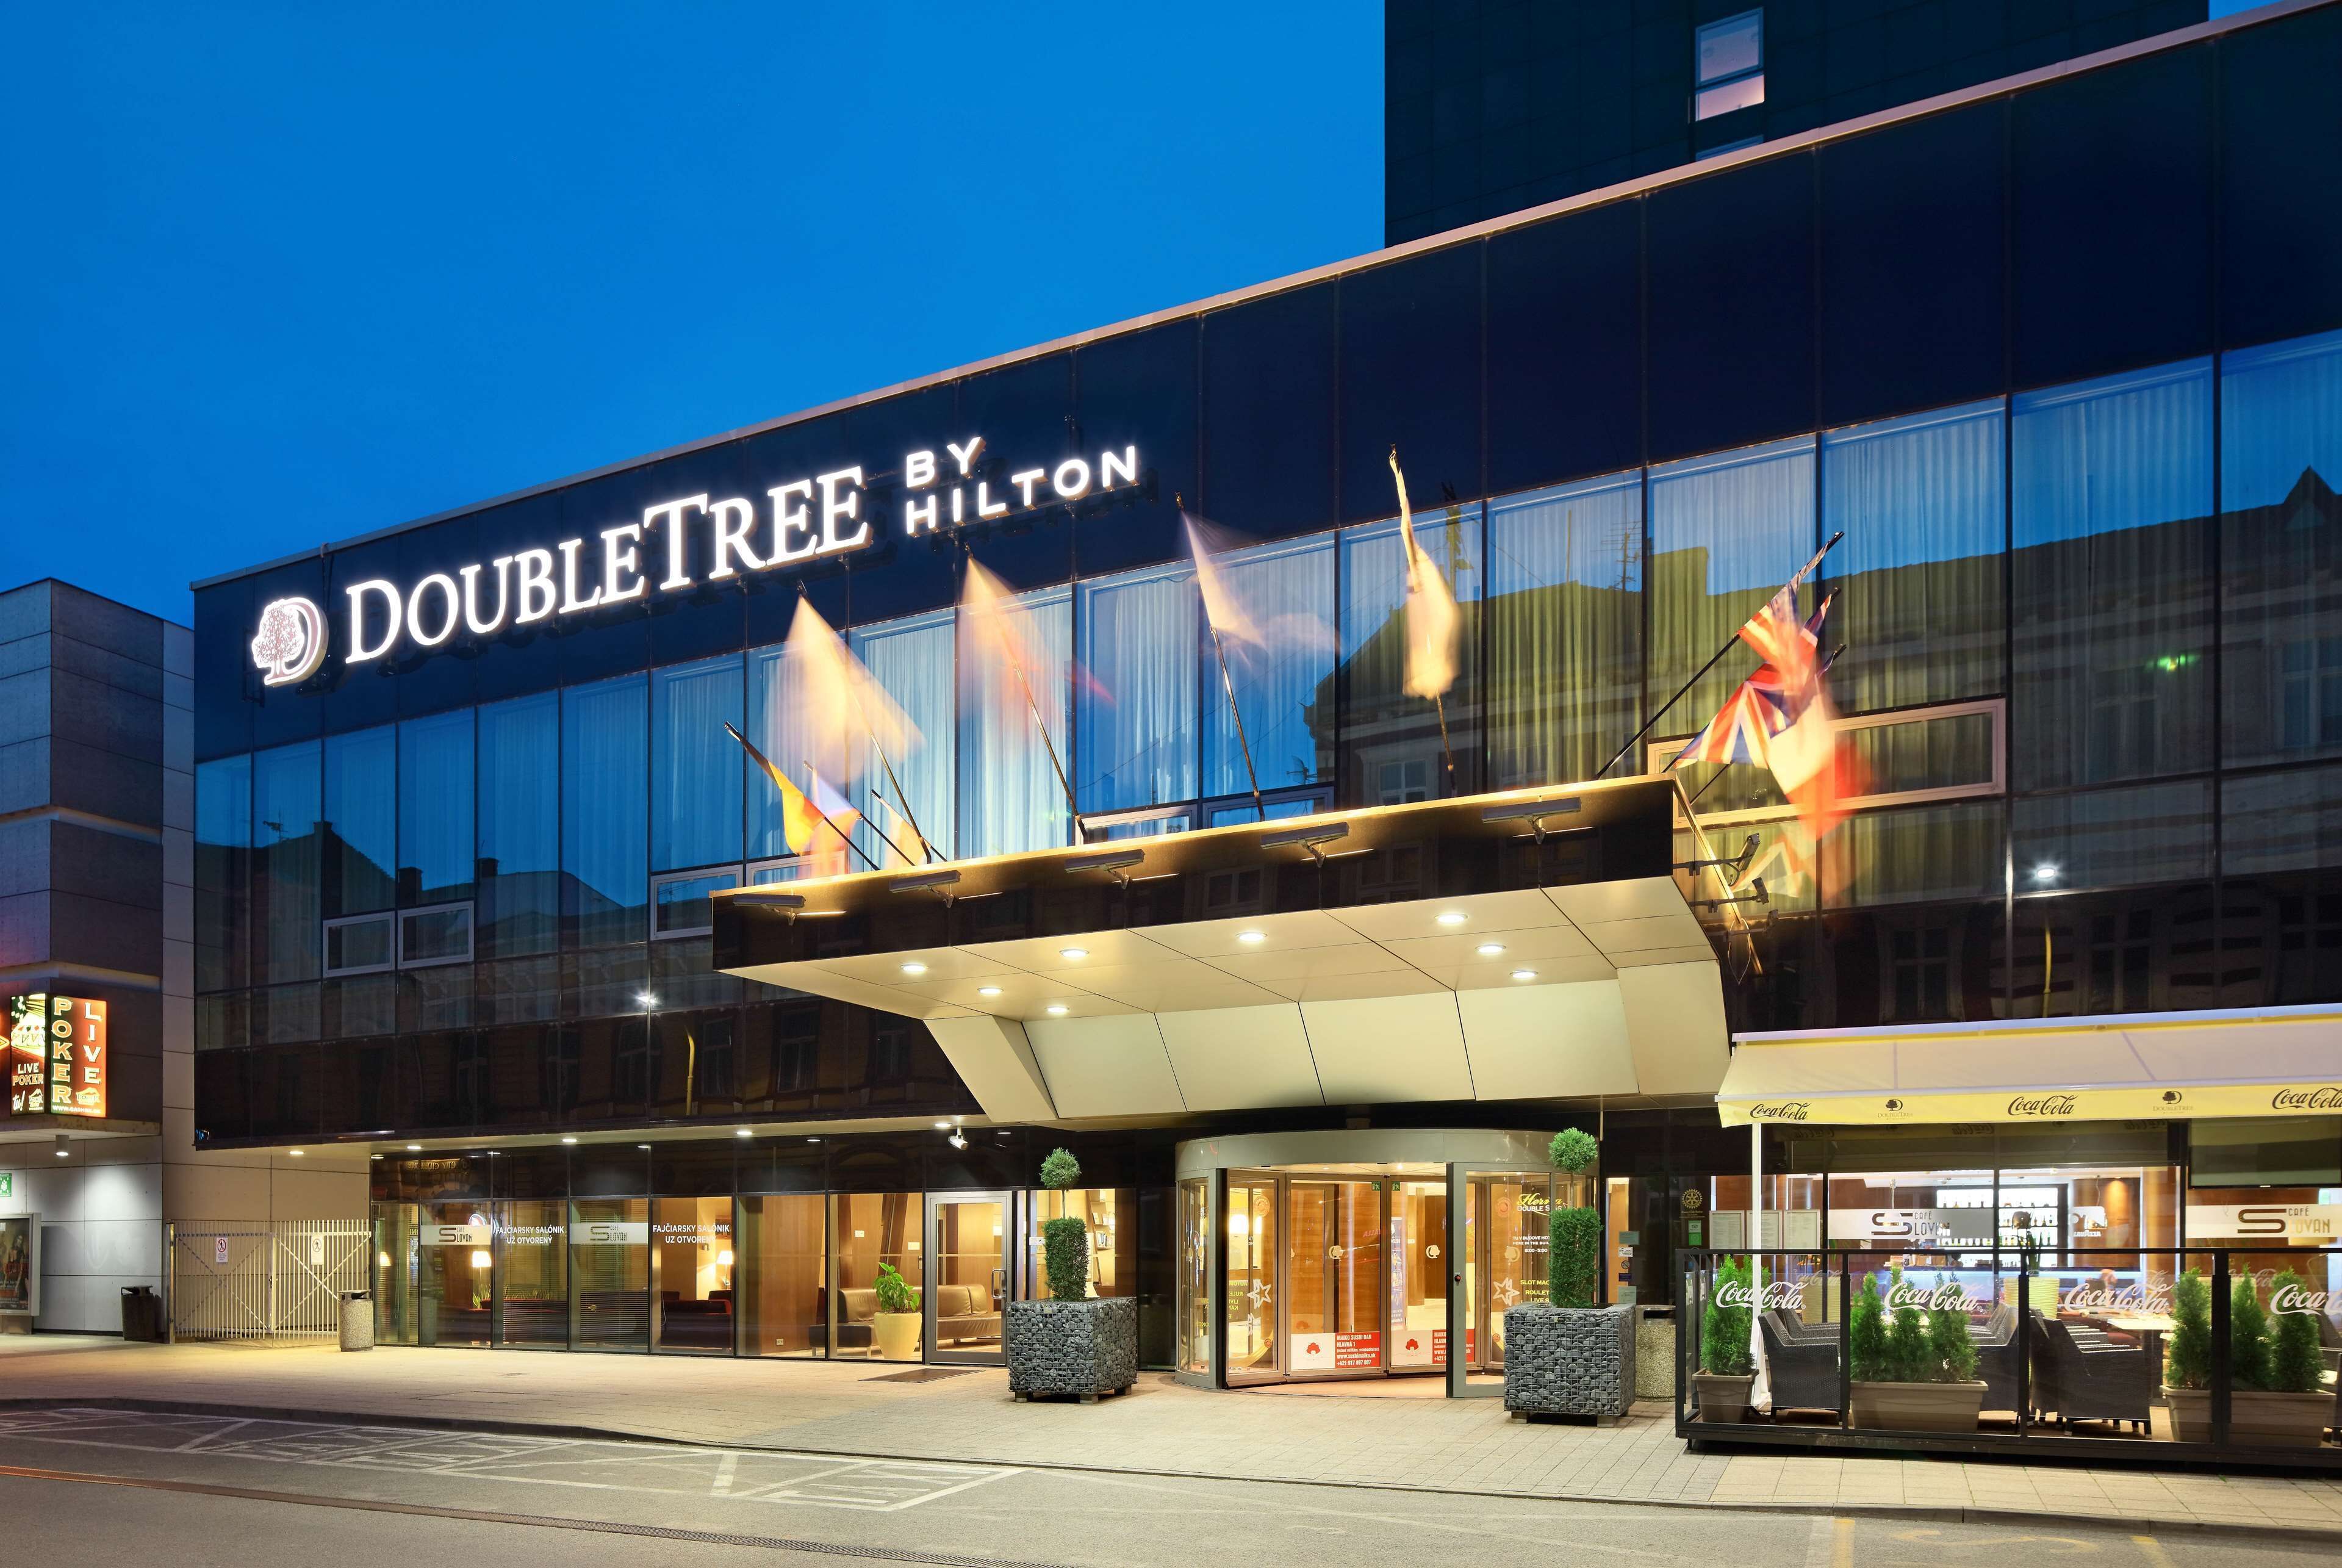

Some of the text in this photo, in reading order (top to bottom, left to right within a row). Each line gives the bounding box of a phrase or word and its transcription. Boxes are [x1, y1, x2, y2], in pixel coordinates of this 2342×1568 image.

[907, 436, 982, 487] BY
[907, 445, 1137, 535] HILTON
[51, 998, 72, 1103] POKER
[83, 1002, 102, 1085] LIVE
[18, 1062, 39, 1074] LIVE
[12, 1073, 44, 1086] POKER
[1750, 1102, 1811, 1120] Coca-Cola
[2008, 1095, 2078, 1116] Coca-Cola
[1914, 1211, 1932, 1220] CAFÉ
[2288, 1206, 2310, 1217] CAFÉ
[536, 1225, 564, 1233] SALÓNIK
[652, 1223, 696, 1232] FAJČIARSKY
[507, 1235, 553, 1244] UŽ OTVORENÝ
[1884, 1281, 1984, 1311] Coca-Cola
[2064, 1282, 2174, 1314] Coca-Cola
